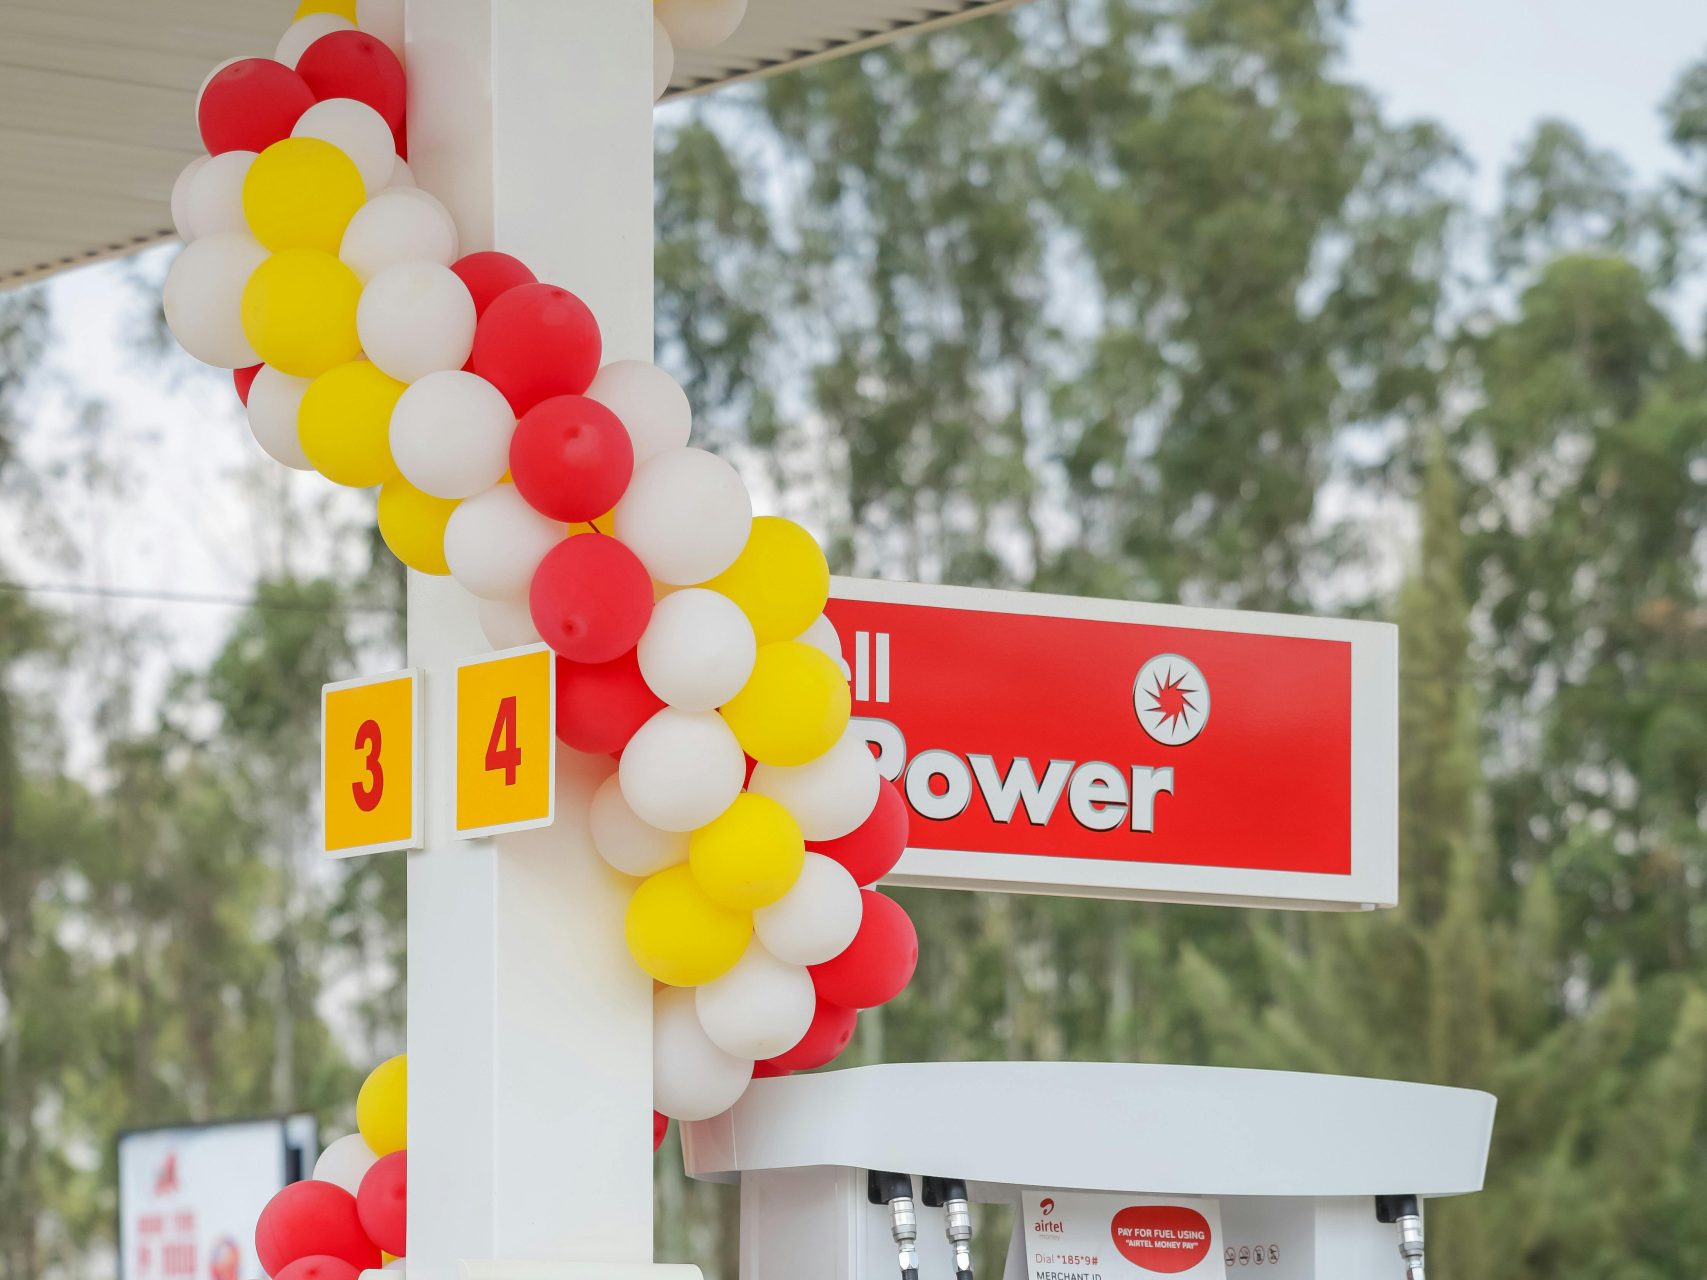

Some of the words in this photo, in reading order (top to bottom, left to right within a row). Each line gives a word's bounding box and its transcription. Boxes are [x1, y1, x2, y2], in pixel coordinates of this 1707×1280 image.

[485, 696, 521, 786] 4
[352, 720, 383, 812] 3
[1035, 1220, 1063, 1232] airtel
[1118, 1228, 1132, 1236] PAY
[1135, 1229, 1152, 1237] FOR
[1154, 1230, 1175, 1238] FUEL
[1178, 1231, 1205, 1239] USING
[1036, 1253, 1054, 1263] Dial
